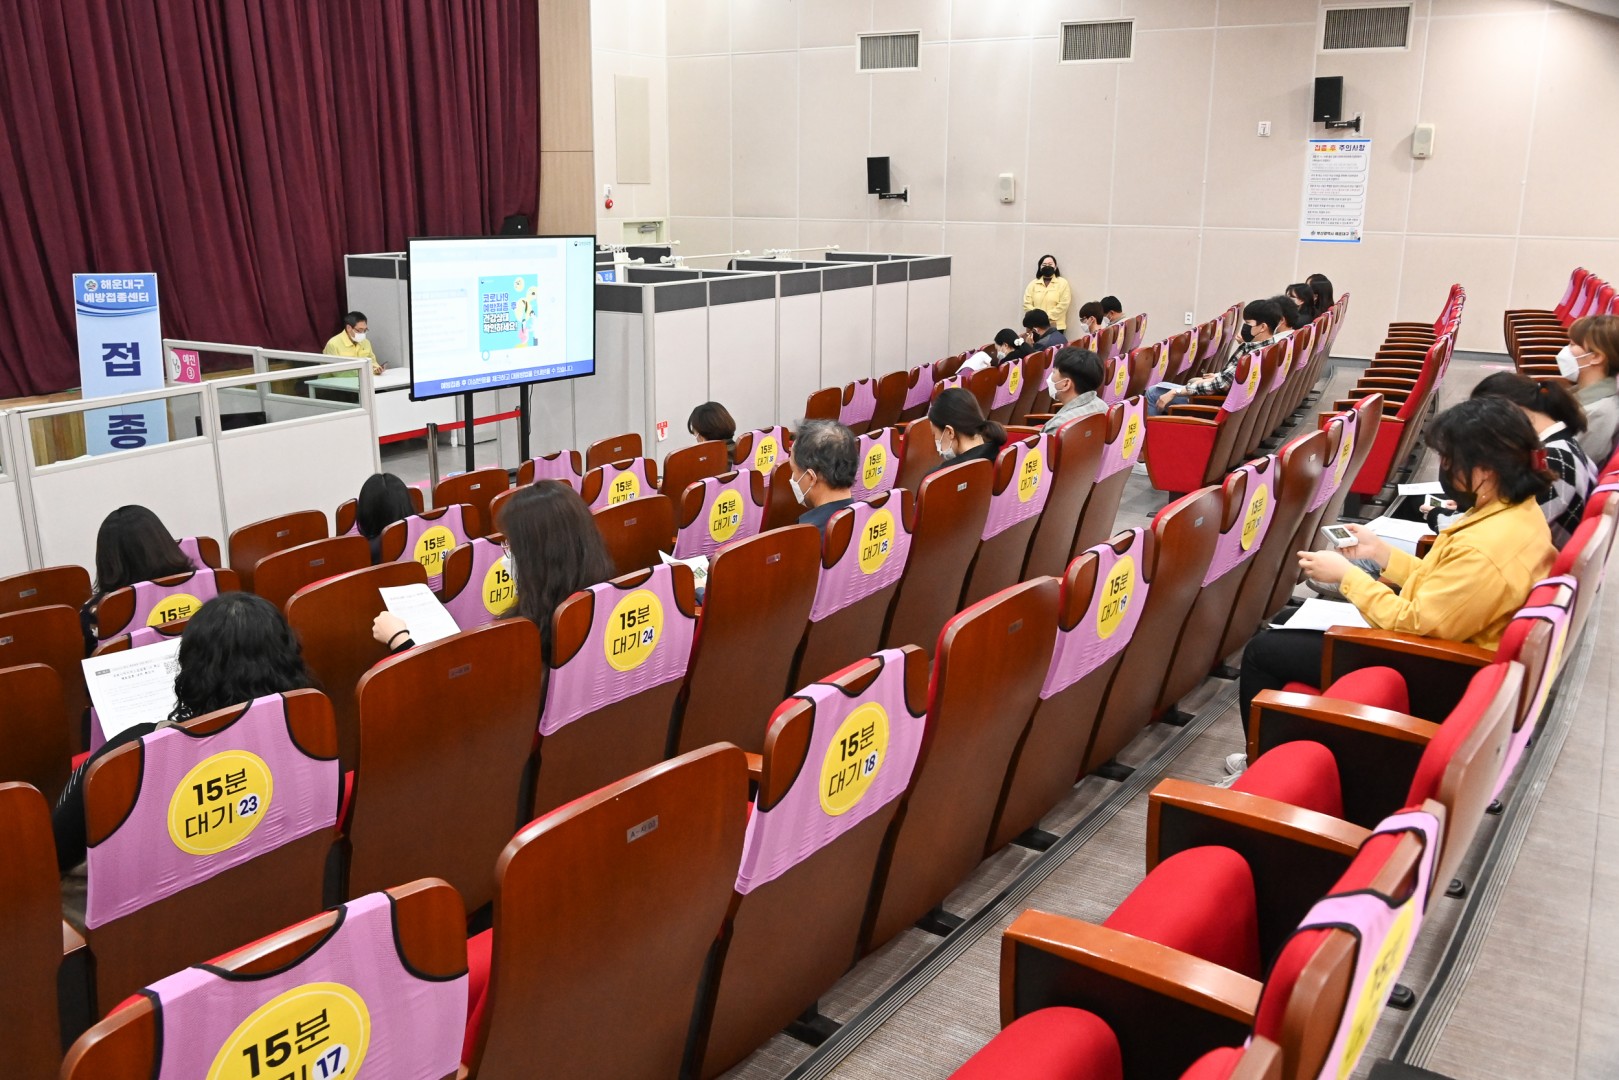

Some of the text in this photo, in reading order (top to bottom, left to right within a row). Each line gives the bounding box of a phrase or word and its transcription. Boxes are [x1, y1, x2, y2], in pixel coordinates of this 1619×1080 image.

[1339, 144, 1366, 152] 주의사항
[100, 279, 145, 290] 해운대구
[83, 292, 149, 303] 예방접종센터
[483, 292, 509, 303] 코로나19
[483, 302, 509, 313] 예방접종
[182, 354, 197, 366] 예진
[440, 382, 461, 390] 예방접종
[761, 444, 772, 454] 15분
[757, 456, 769, 466] 대기
[869, 453, 882, 466] 15분
[1025, 459, 1038, 474] 15분
[865, 467, 877, 480] 대기
[616, 479, 632, 493] 15분
[1020, 474, 1032, 491] 대기
[612, 494, 628, 504] 대기
[717, 498, 736, 515] 15분
[713, 514, 738, 531] 대기 31
[868, 521, 888, 541] 15분
[424, 535, 446, 551] 15분
[863, 539, 888, 562] 대기 25
[420, 551, 440, 567] 대기
[495, 570, 513, 584] 15
[1109, 571, 1128, 596] 15분
[490, 585, 514, 603] 대기
[159, 604, 192, 624] 15분
[619, 604, 650, 630] 15분
[1101, 598, 1120, 623] 대기
[613, 628, 653, 656] 대기 24
[840, 721, 875, 762] 15분
[828, 754, 876, 797] 대기 18
[192, 768, 248, 806] 15분
[185, 795, 258, 839] 대기 23
[242, 1008, 330, 1079] 15분
[316, 1046, 342, 1079] 17
